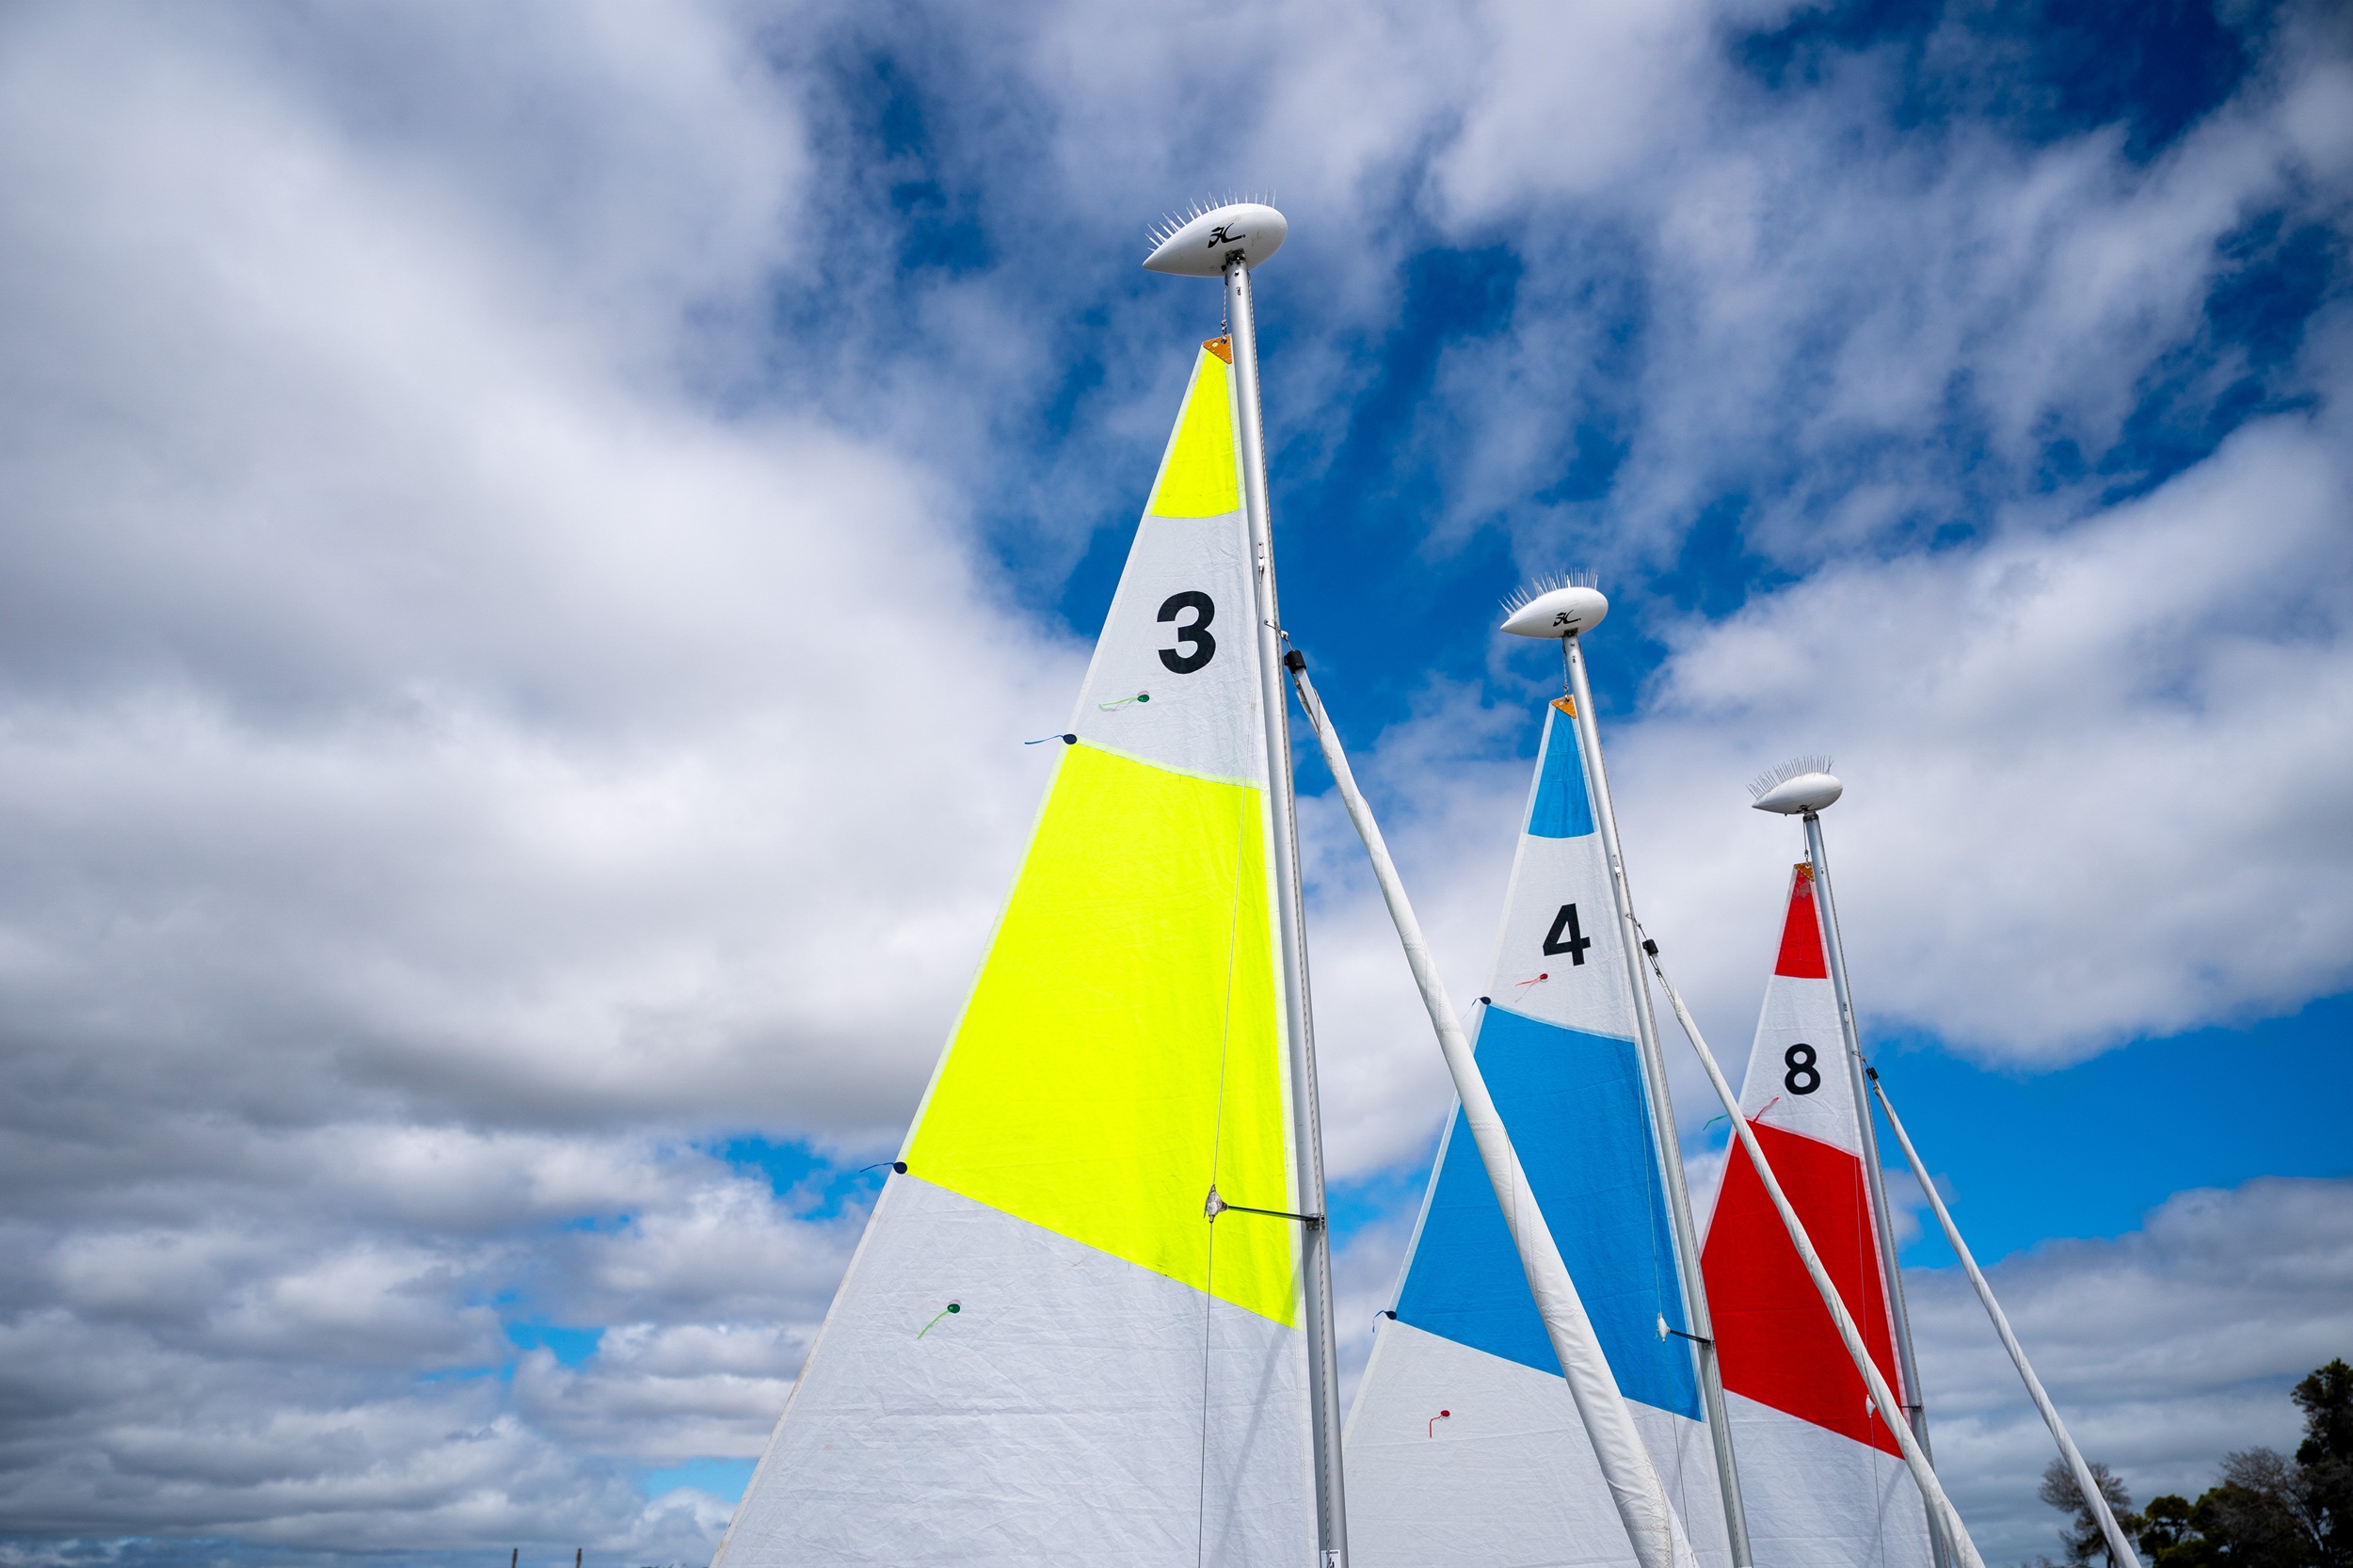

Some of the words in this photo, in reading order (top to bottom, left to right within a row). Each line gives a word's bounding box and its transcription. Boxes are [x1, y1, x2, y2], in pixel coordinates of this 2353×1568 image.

[1157, 591, 1216, 675] 3
[1543, 904, 1592, 967] 4
[1785, 1044, 1821, 1096] 8
